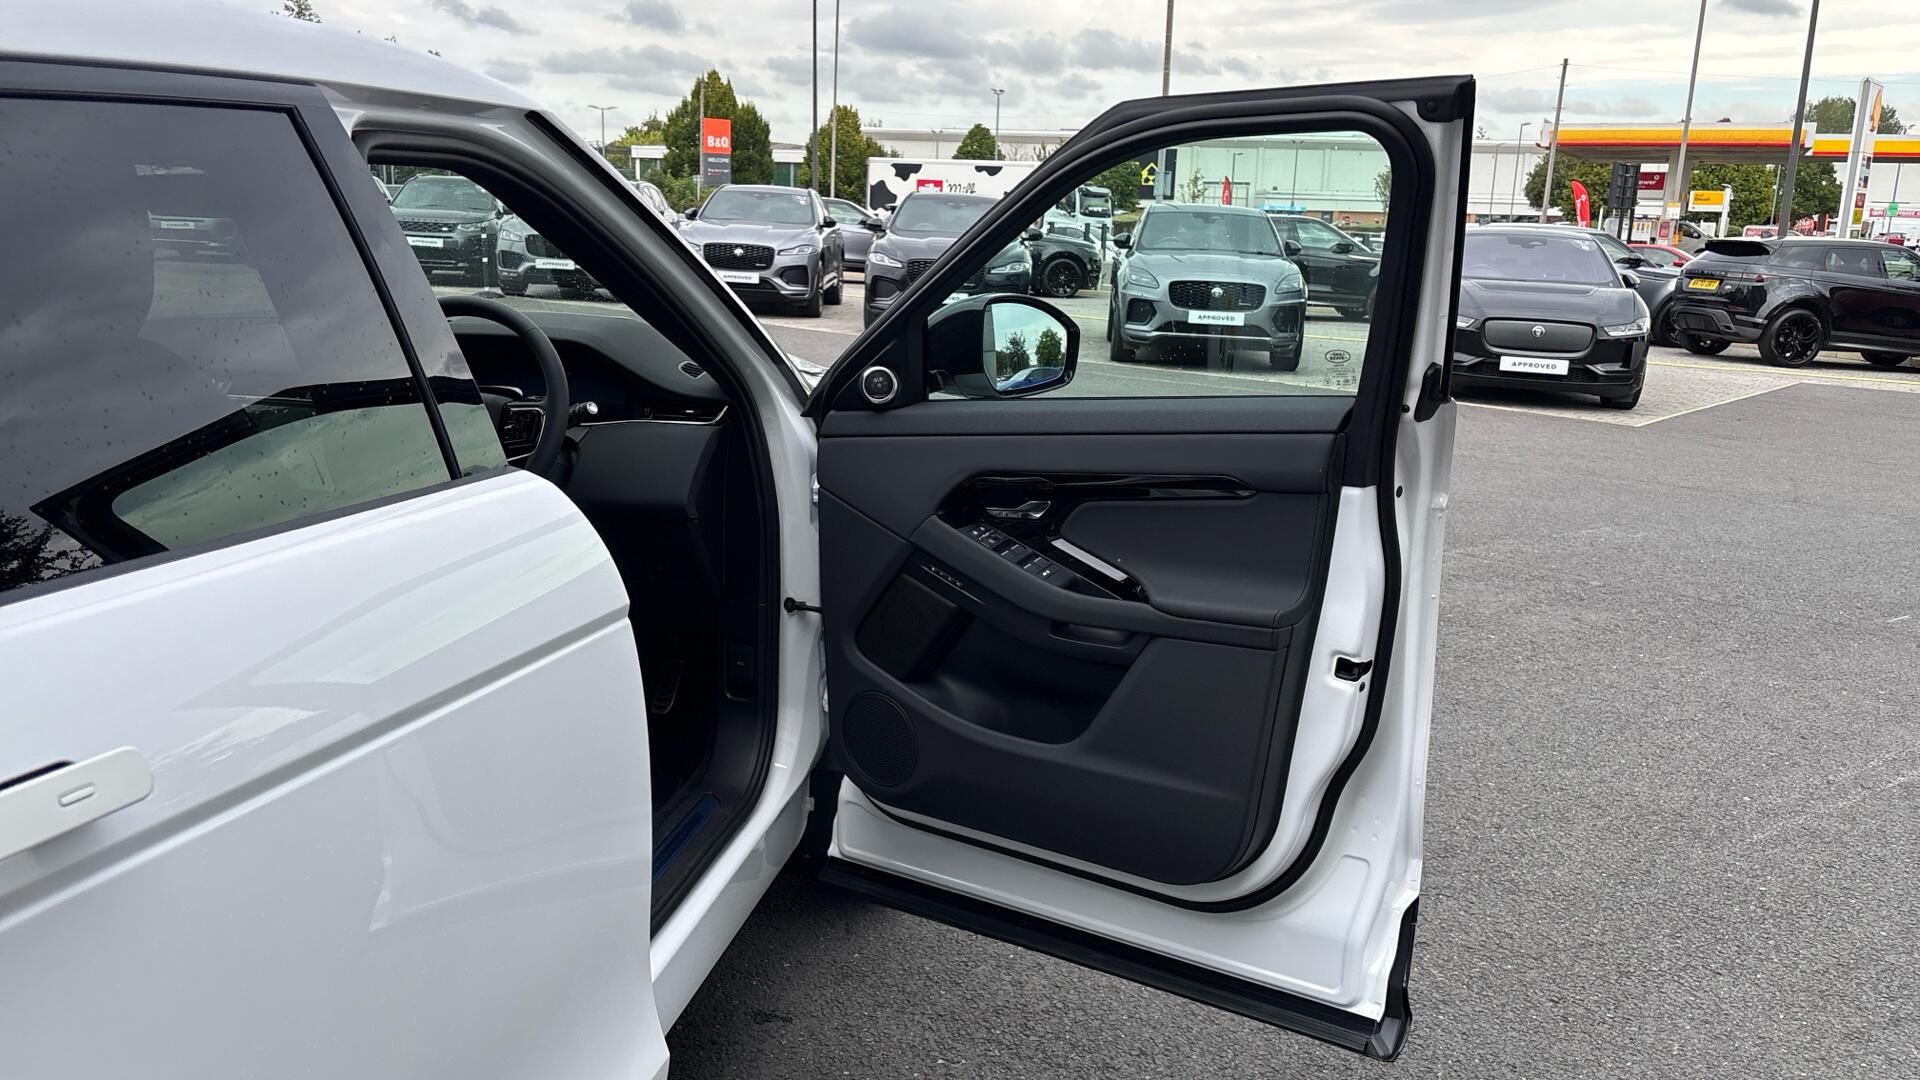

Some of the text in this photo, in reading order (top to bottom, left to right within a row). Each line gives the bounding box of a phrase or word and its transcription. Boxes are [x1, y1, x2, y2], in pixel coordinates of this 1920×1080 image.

[707, 135, 729, 148] B&Q
[1198, 314, 1236, 322] APPROVED
[1511, 361, 1557, 370] APPROVED
